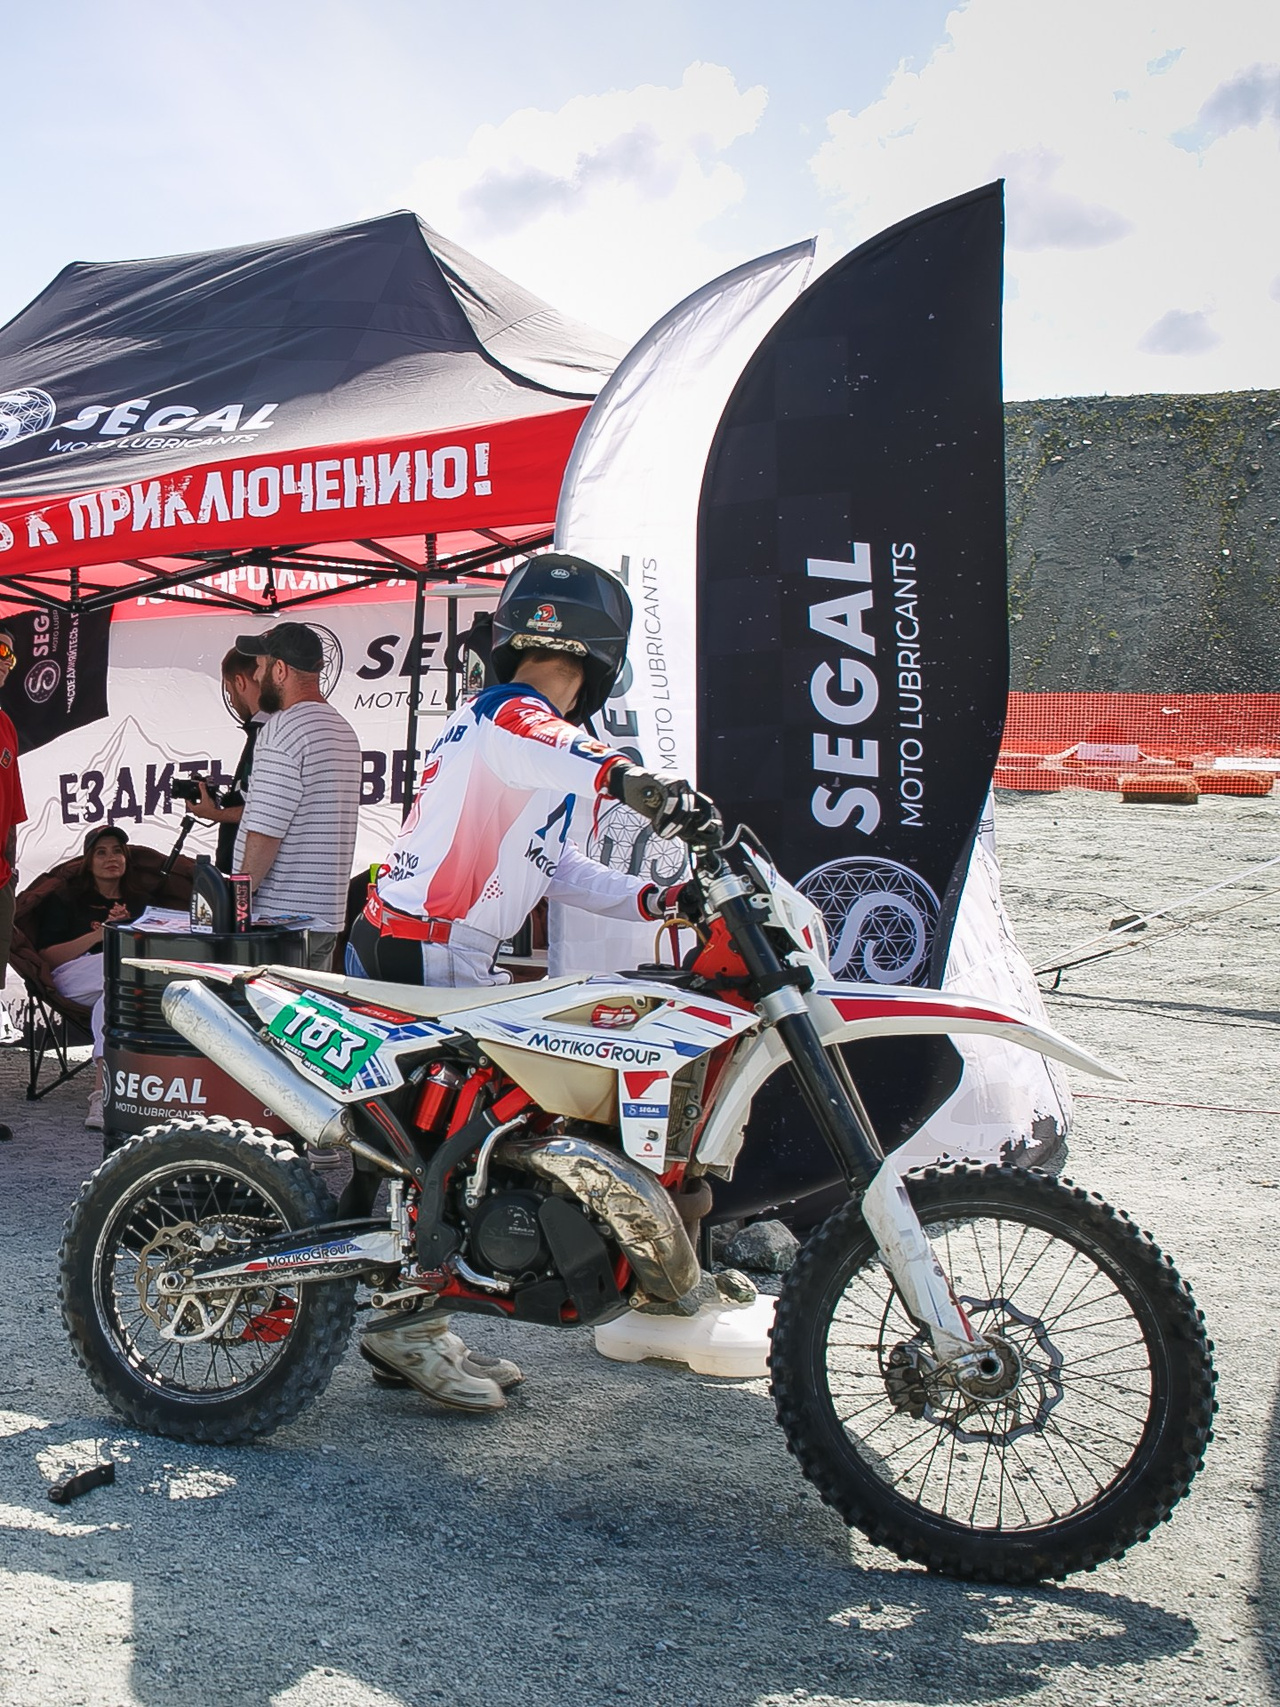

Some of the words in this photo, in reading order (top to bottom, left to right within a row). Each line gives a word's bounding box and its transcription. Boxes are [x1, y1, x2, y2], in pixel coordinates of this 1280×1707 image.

[48, 438, 116, 453] MOTO
[117, 433, 259, 450] LUBRICANTS
[60, 399, 280, 435] SEGAL
[68, 441, 493, 541] ПРИКЛЮЧЕНИЮ!
[33, 608, 50, 656] SEG
[642, 557, 671, 701] LUBRICANTS
[891, 542, 924, 729] LUBRICANTS
[806, 540, 881, 836] SEGAL
[653, 707, 679, 771] MOTO
[900, 739, 925, 827] MOTO
[236, 884, 249, 922] VOLT
[283, 1006, 369, 1073] 183
[114, 1070, 207, 1104] SEGAL
[114, 1101, 138, 1114] MOTO
